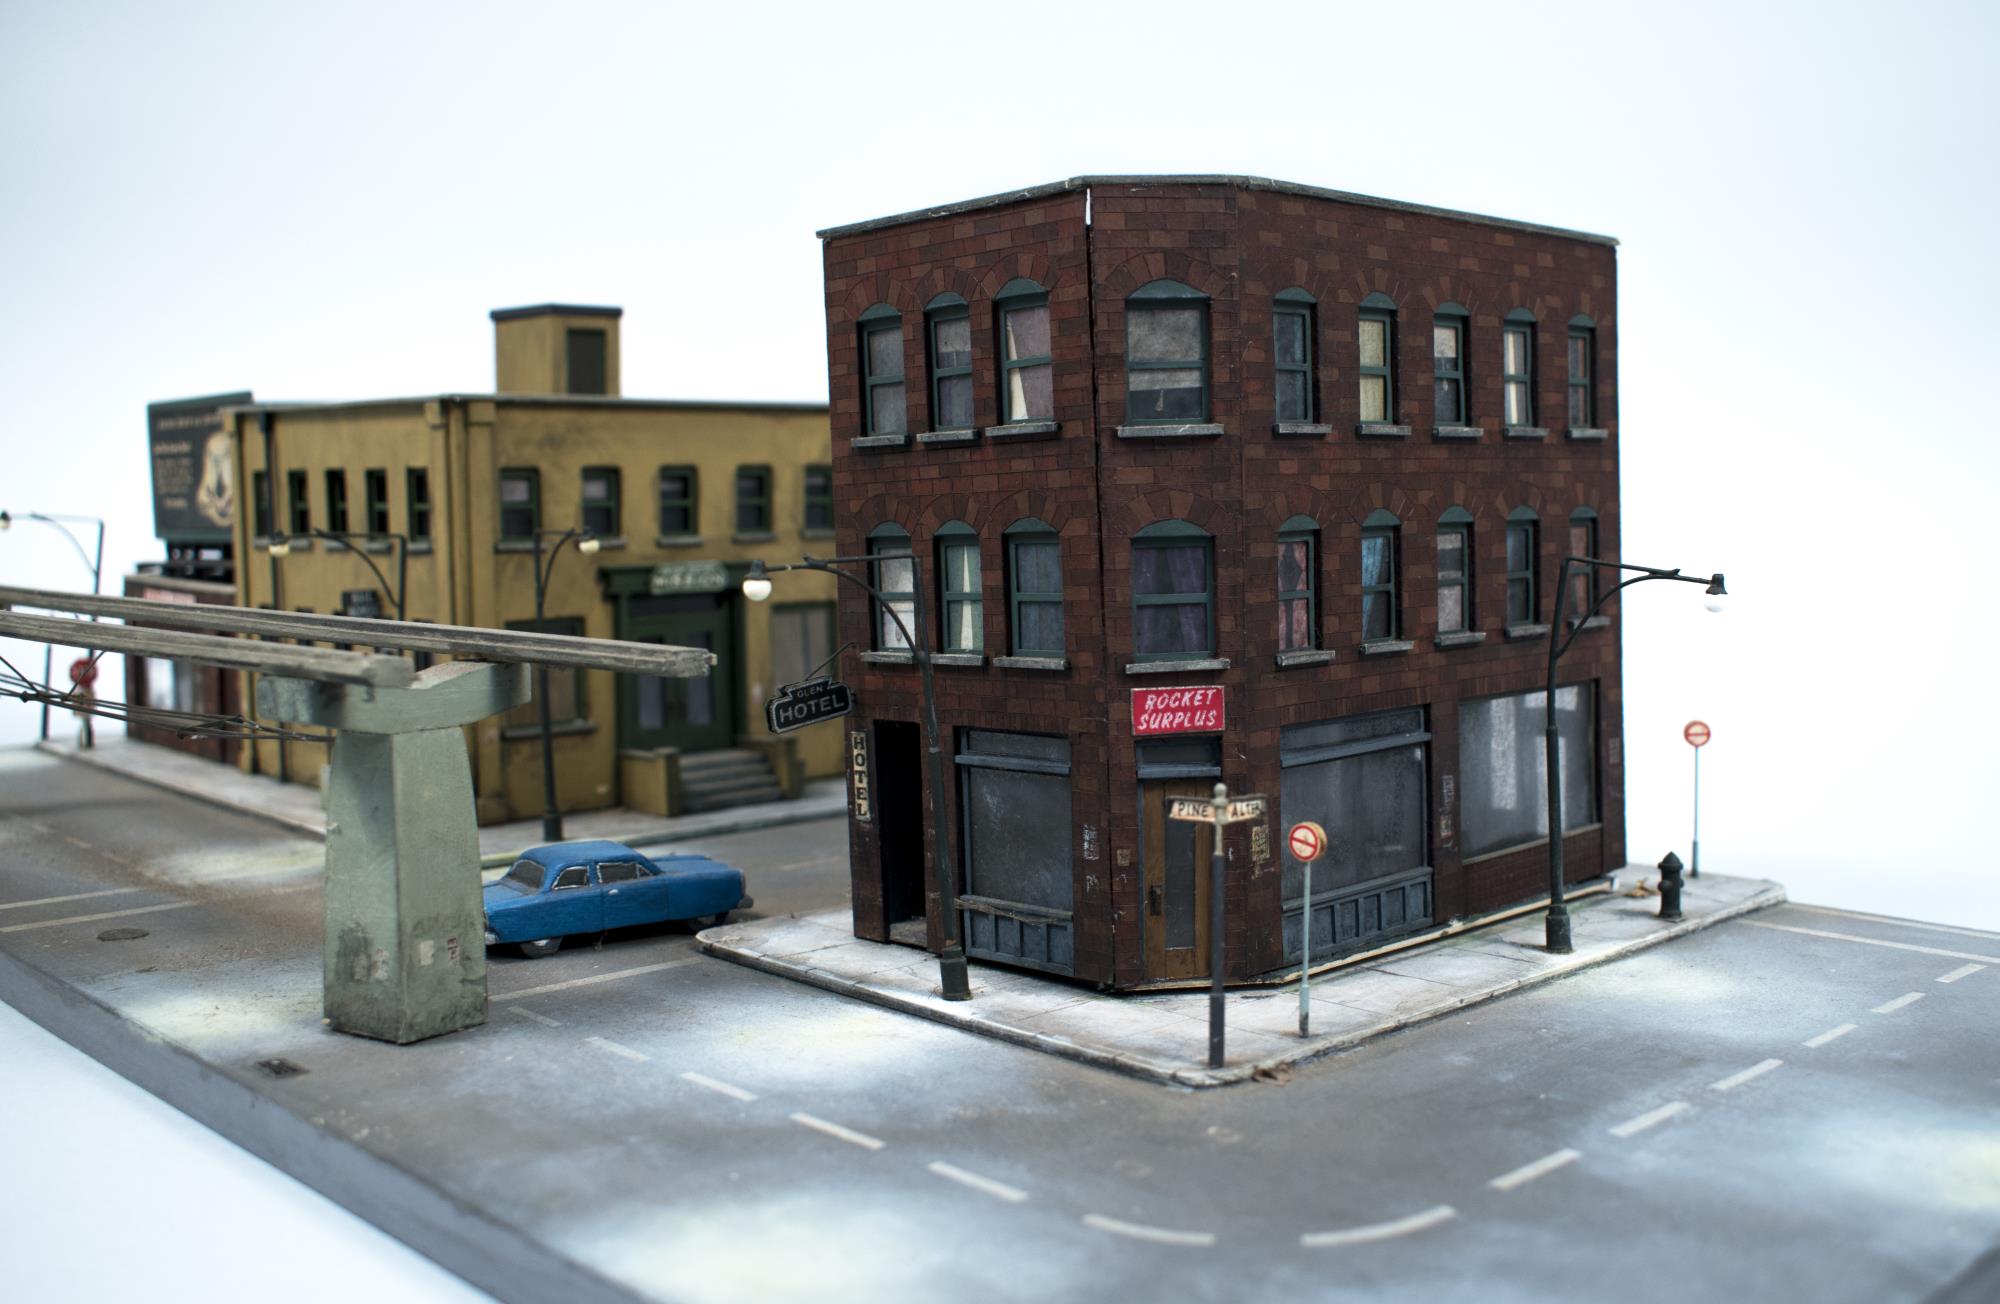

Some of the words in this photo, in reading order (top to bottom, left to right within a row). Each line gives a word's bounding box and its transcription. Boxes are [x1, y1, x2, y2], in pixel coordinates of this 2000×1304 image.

[797, 685, 823, 698] GLEN
[1144, 689, 1217, 711] ROCKET
[779, 695, 844, 723] HOTEL
[1137, 709, 1217, 730] SURPLUS
[853, 736, 868, 817] HOTEL
[1177, 801, 1210, 818] PINE
